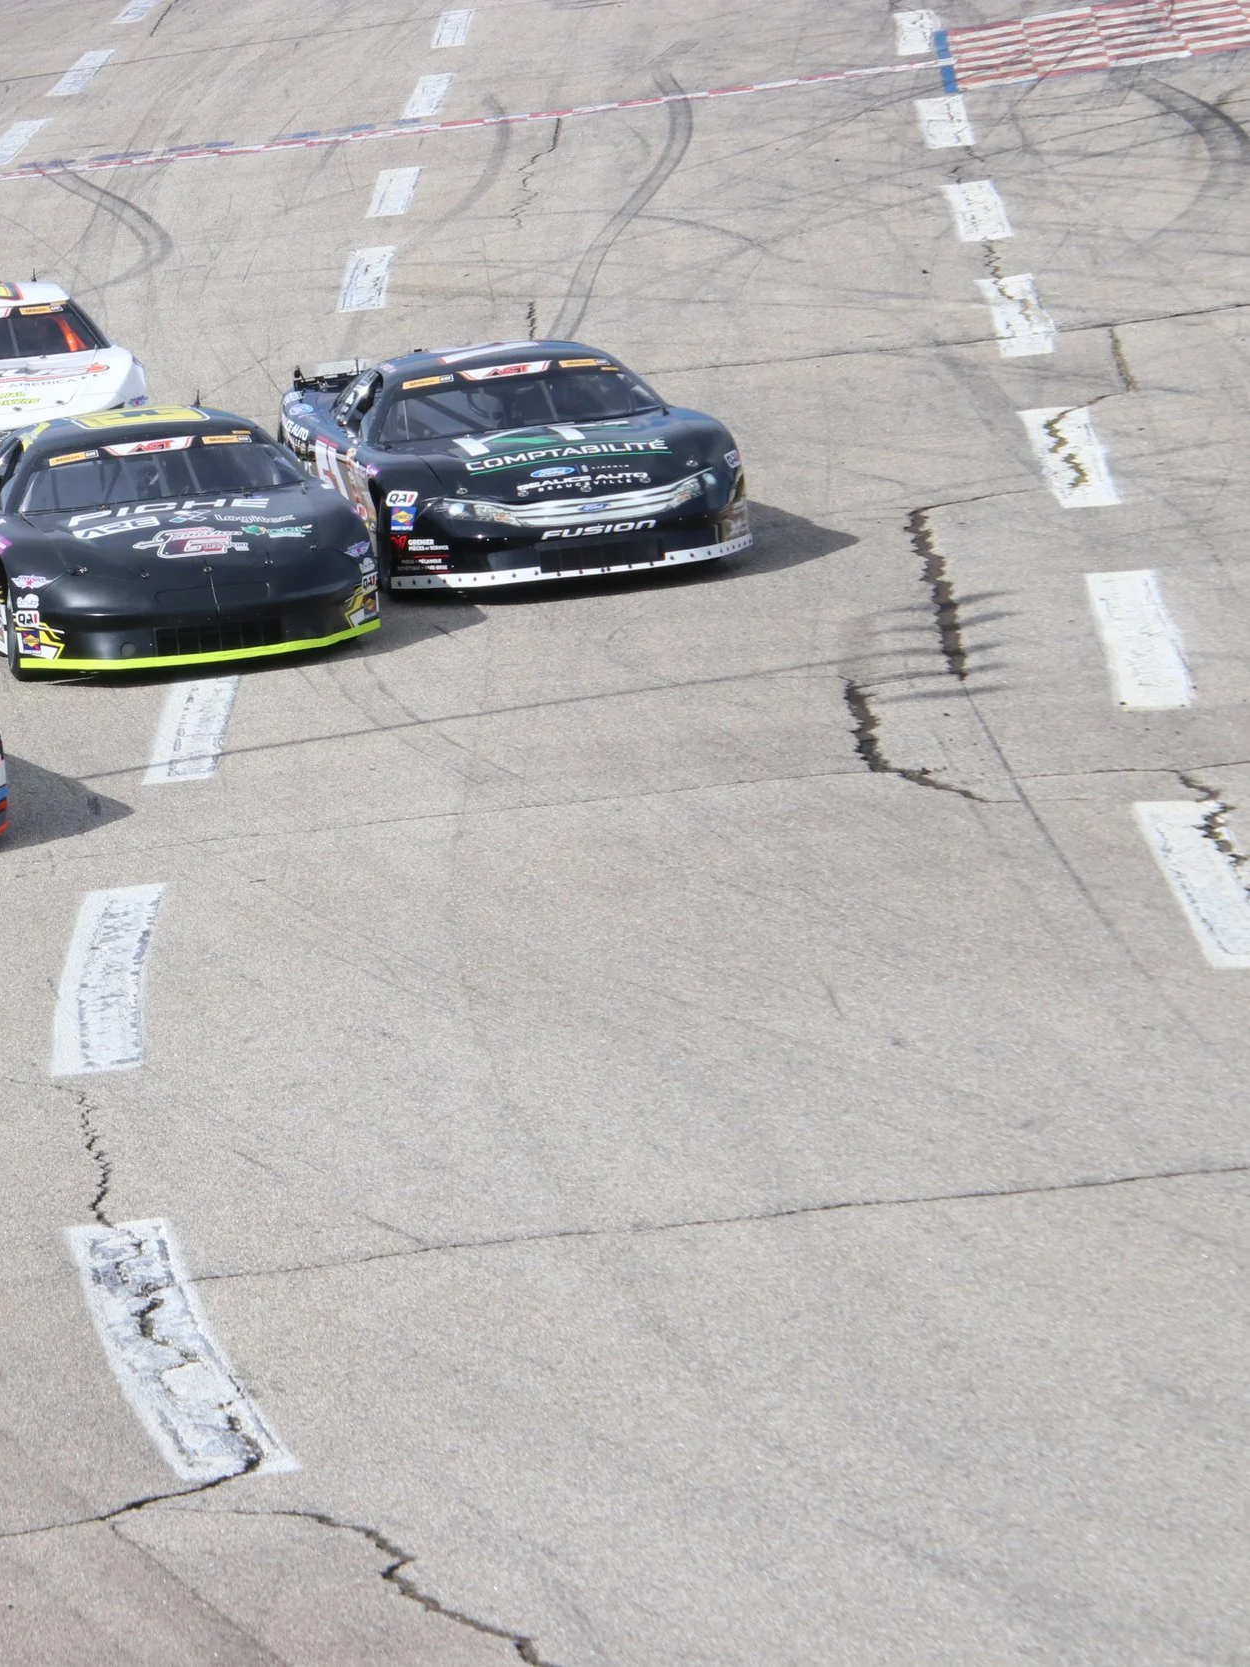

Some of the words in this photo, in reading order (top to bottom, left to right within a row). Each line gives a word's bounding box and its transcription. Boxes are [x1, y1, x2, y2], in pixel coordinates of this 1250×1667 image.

[465, 438, 669, 472] COMPTABILITÉ
[517, 475, 591, 491] BEAUCE
[595, 472, 649, 480] AUTO
[68, 498, 270, 527] PICHE
[541, 519, 656, 540] FUSION
